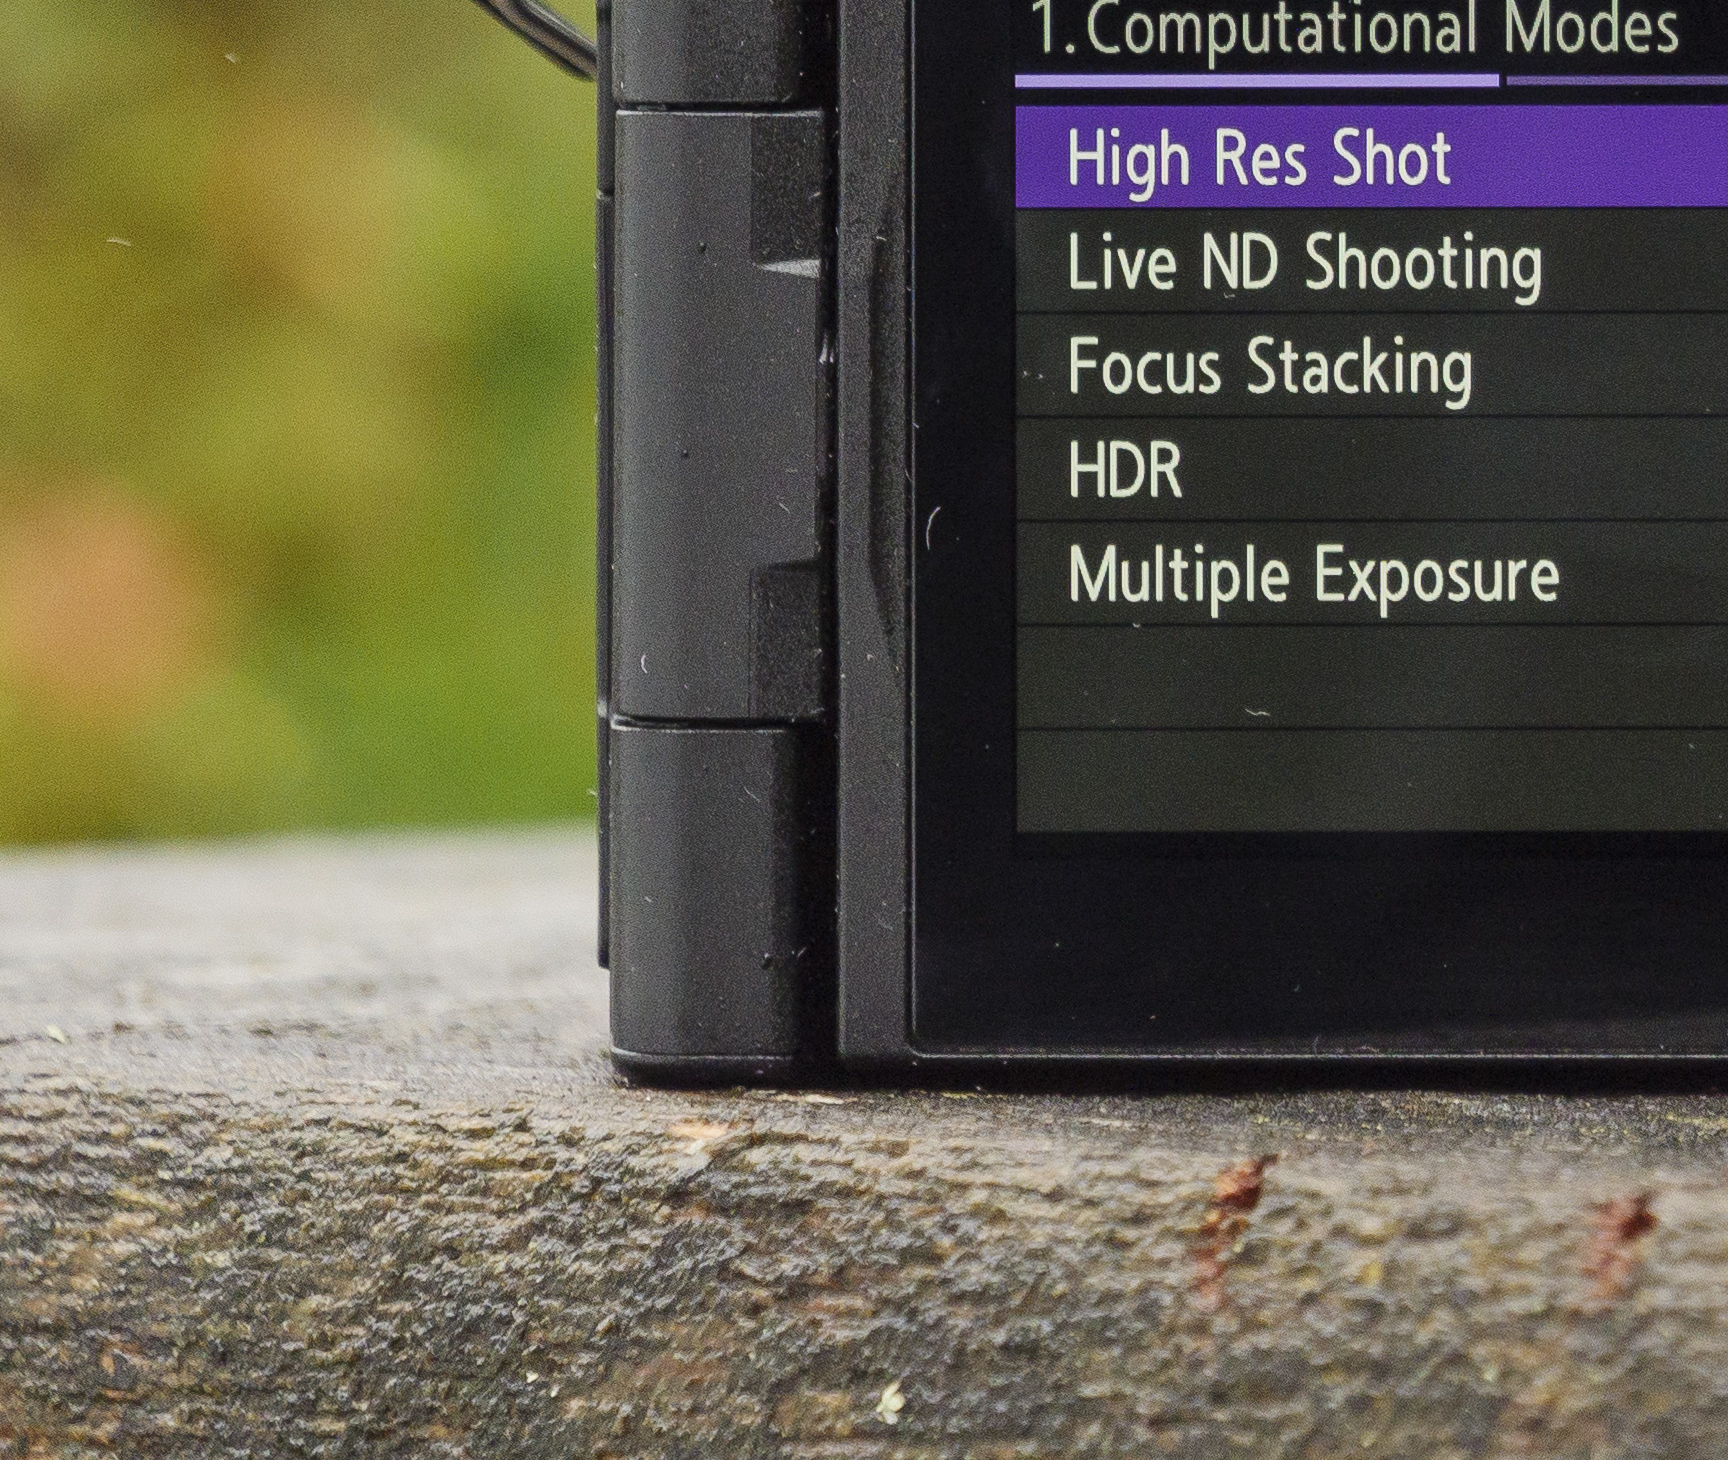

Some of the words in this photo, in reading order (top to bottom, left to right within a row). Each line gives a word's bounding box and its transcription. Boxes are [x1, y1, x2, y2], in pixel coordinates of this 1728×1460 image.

[1069, 127, 1190, 203] High
[1216, 127, 1307, 186] Res
[1333, 126, 1452, 186] Shot
[1069, 232, 1176, 290] Live
[1203, 232, 1279, 290] ND
[1305, 230, 1542, 306] Shooting
[1070, 336, 1222, 395] Focus
[1247, 335, 1472, 411] Stacking
[1070, 439, 1183, 498] HDR
[1070, 543, 1290, 618] Multiple
[1316, 543, 1560, 618] Exposure
